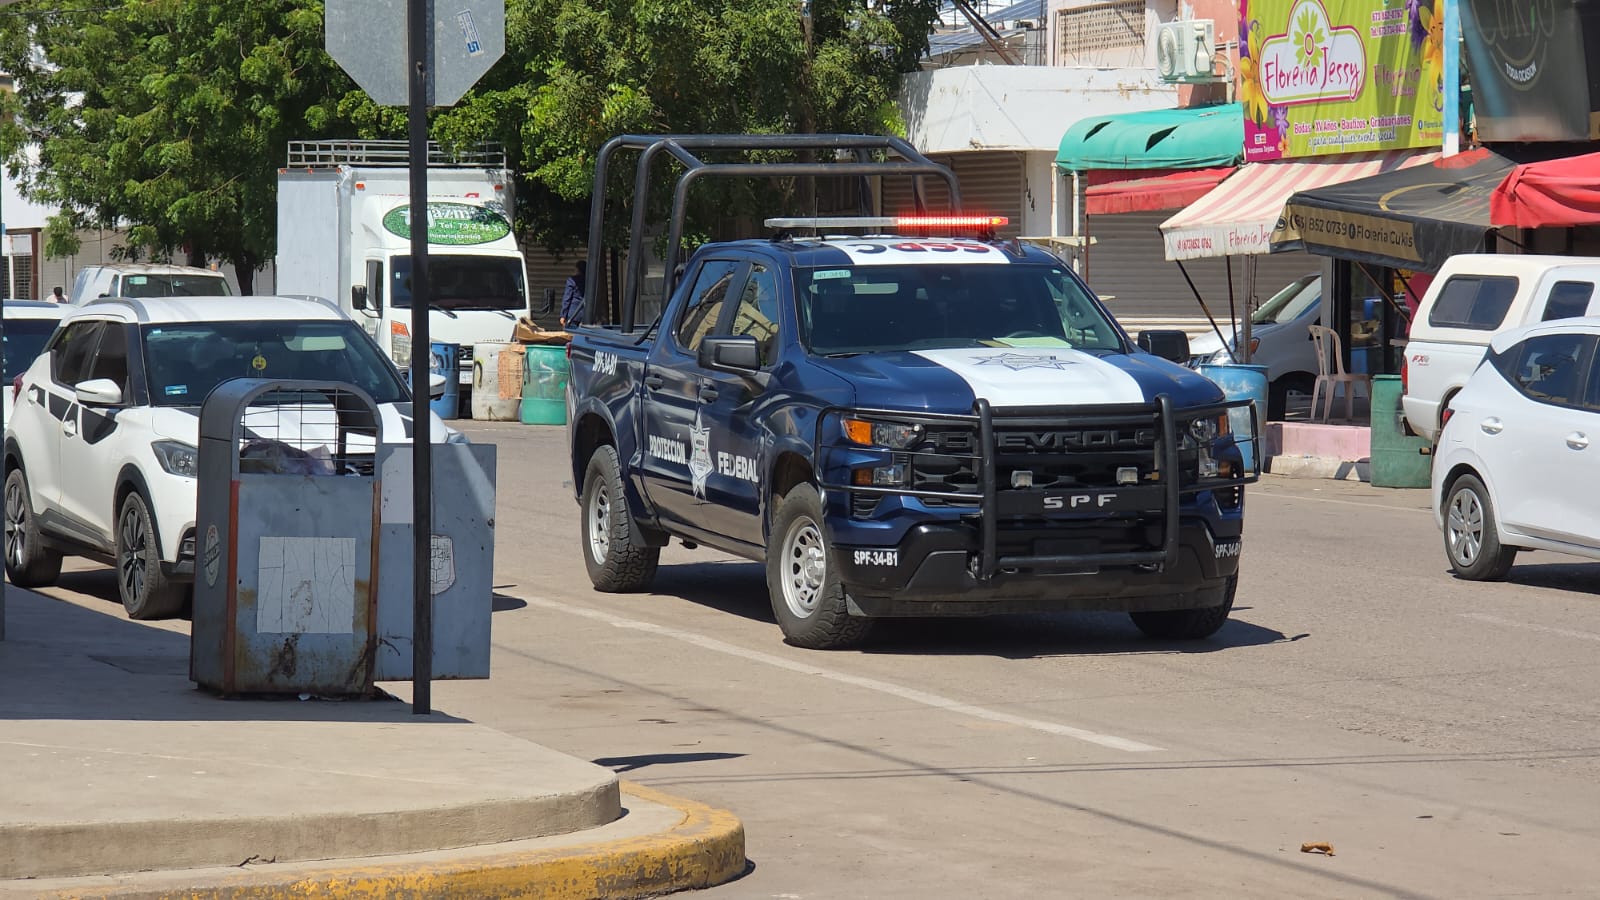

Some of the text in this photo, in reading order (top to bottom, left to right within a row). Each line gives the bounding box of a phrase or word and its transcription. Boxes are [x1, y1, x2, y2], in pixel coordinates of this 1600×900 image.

[1265, 46, 1361, 100] Florería Jessy
[1341, 117, 1367, 131] Bautizos
[1309, 217, 1324, 233] 852
[1326, 219, 1348, 236] 0739
[1390, 230, 1413, 248] Cukis
[649, 433, 759, 483] PROTECCIÓN FEDERAL
[1043, 493, 1118, 509] SPF
[854, 549, 898, 567] SPF-34-B1
